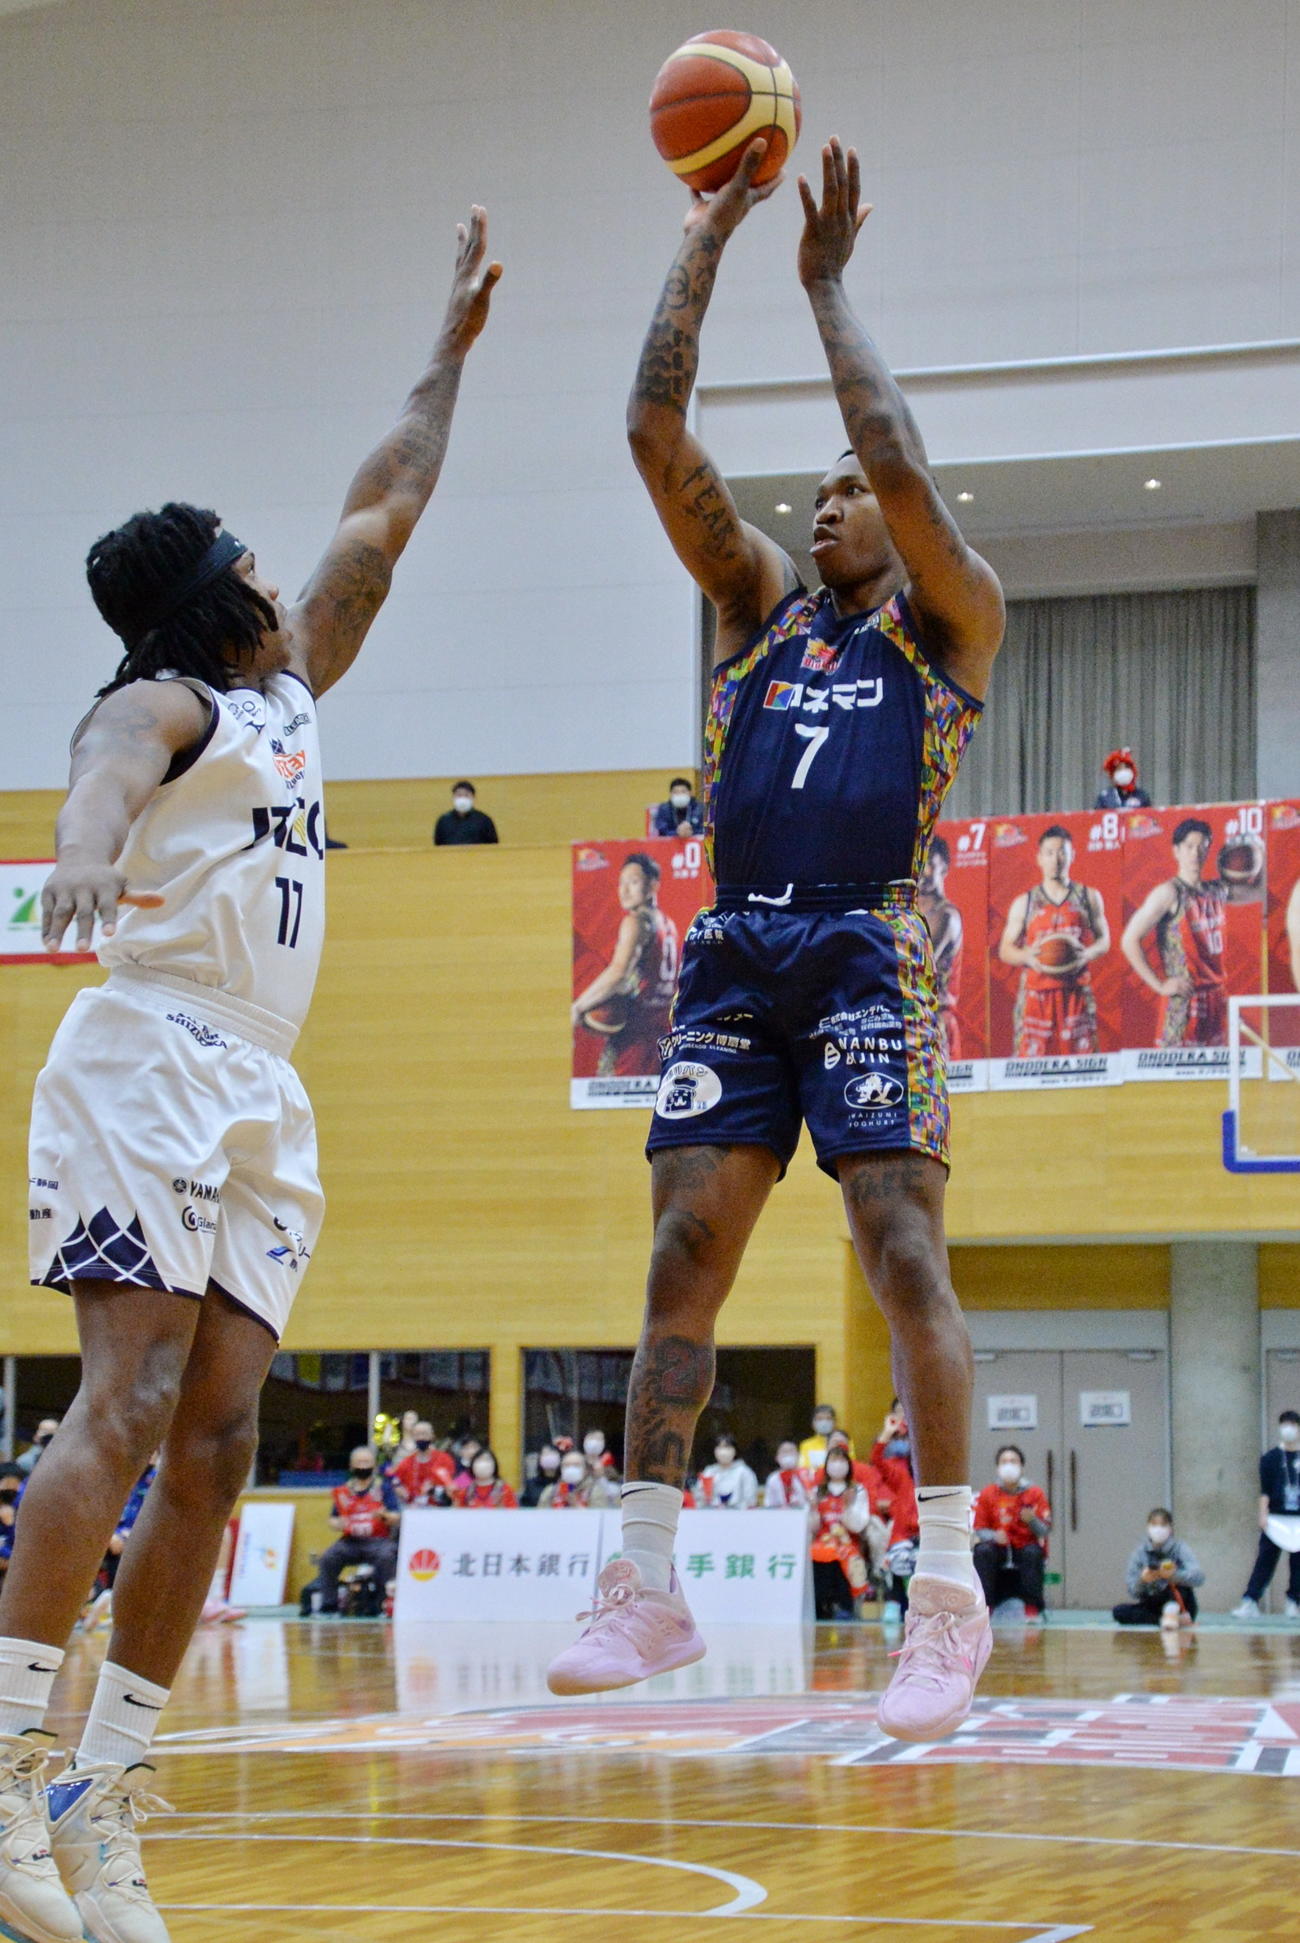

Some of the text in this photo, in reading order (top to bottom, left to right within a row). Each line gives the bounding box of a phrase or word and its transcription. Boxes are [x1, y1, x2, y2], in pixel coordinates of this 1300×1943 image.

[791, 723, 829, 789] 7
[275, 876, 303, 949] 11
[839, 1036, 902, 1051] NANBU
[1213, 1050, 1246, 1064] SIN
[453, 1552, 590, 1578] 北日本銀行
[672, 1553, 797, 1579] 手銀行
